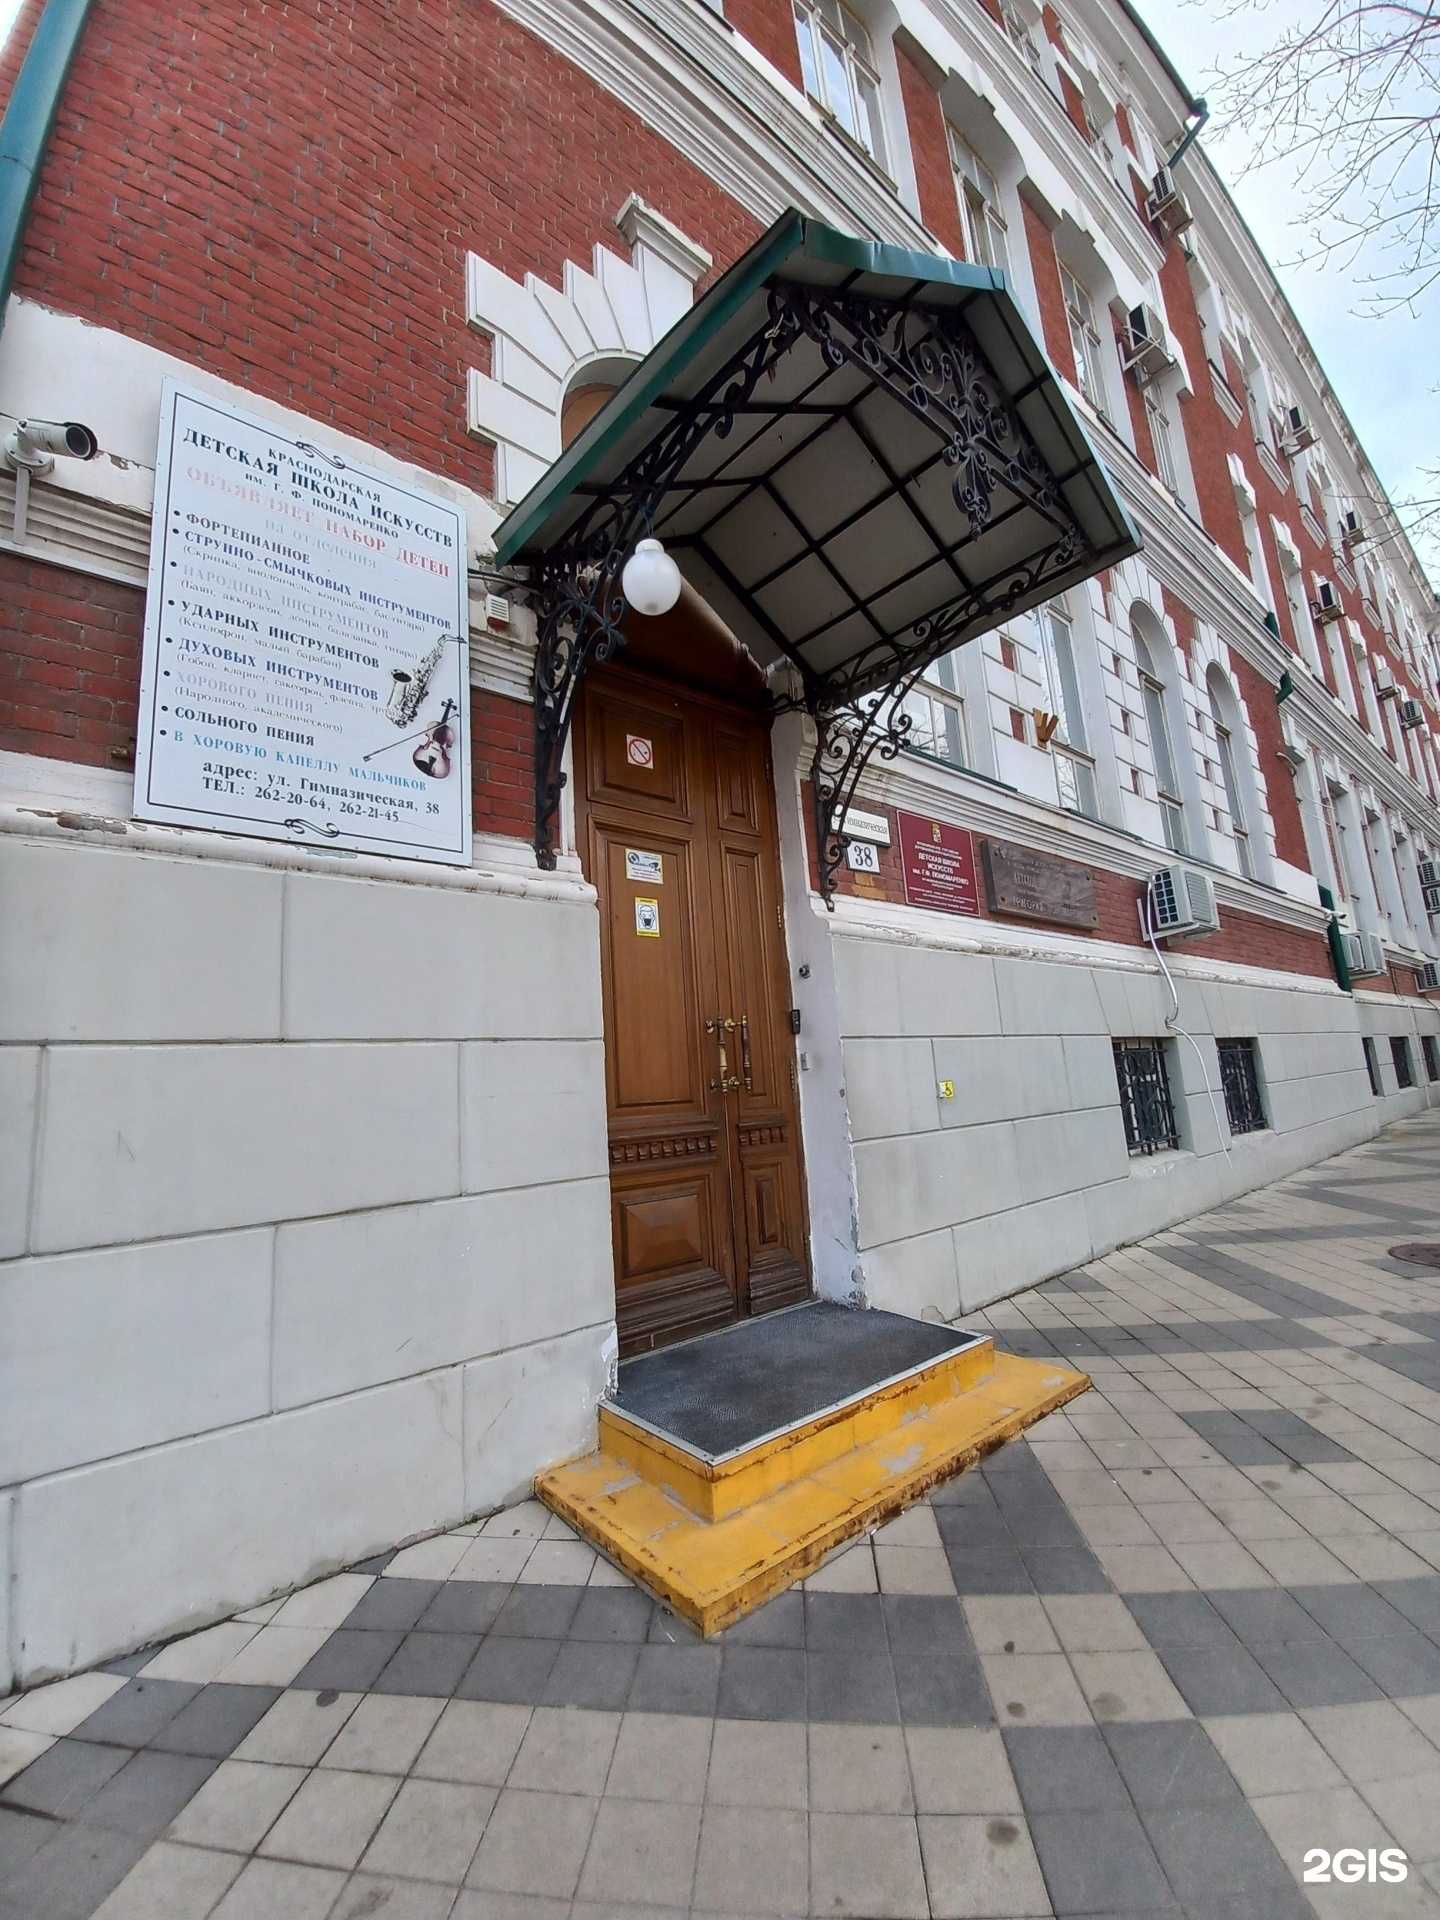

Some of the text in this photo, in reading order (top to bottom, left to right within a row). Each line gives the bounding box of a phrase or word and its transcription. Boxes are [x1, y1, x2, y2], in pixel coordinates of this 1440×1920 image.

[183, 427, 452, 548] ДЕТСКАЯ ШКОЛА ИСКУССТВ
[268, 447, 381, 502] КРАСНОДАРСКАЯ
[186, 466, 314, 523] ОБЪЯВЛЯЕТ
[324, 519, 386, 551] НАБОР
[312, 497, 399, 539] ПОНОМАРЕНКО
[186, 513, 310, 565] ФОРТЕПИАННОЕ
[184, 564, 390, 640] НАРОДНЫХ ИНСТРУМЕНТОВ
[359, 590, 451, 630] ИНСТРУМЕНТОВ
[181, 599, 380, 668] УДАРНЫХ ИНСТРУМЕНТОВ
[176, 671, 313, 715] ХОРОВОГО ПЕНИЯ
[178, 637, 378, 700] ДУХОВЫХ ИНСТРУМЕНТОВ
[175, 706, 315, 746] СОЛЬНОГО ПЕНИЯ
[174, 730, 427, 792] В ХОРОВУЮ КАПЕЛЛУ МАЛЬЧИКОВ
[202, 761, 440, 815] адрес: ул. Гимназическая, 38
[202, 775, 399, 823] ТЕЛ.: 262-20-64, 262-21-45
[854, 845, 874, 868] 38
